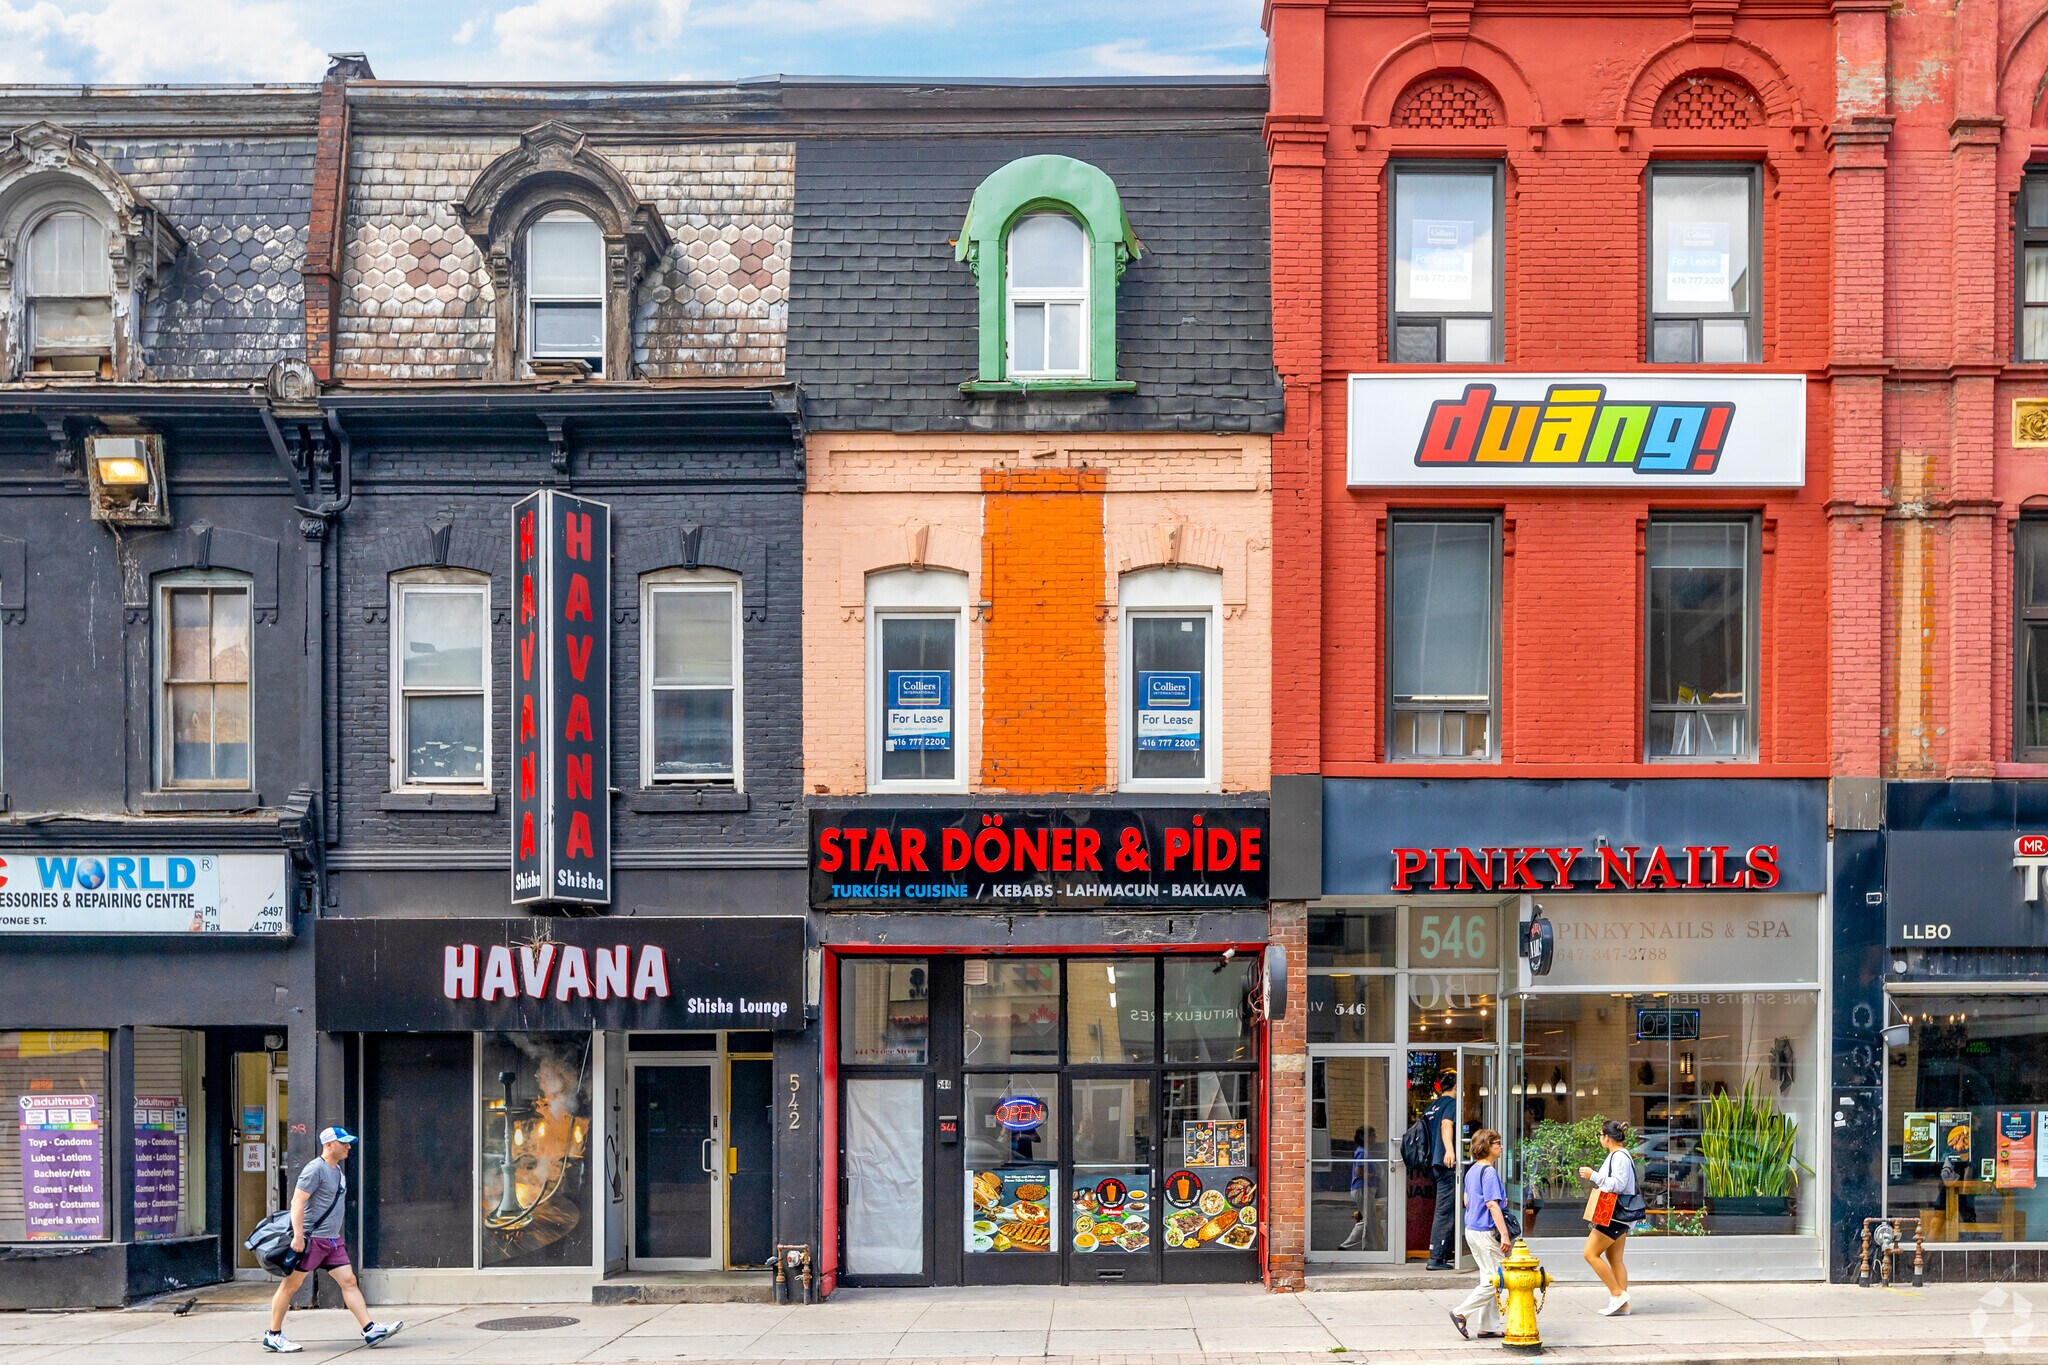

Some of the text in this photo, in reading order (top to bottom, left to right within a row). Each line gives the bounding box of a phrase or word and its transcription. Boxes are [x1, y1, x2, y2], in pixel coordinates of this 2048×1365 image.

[1671, 256, 1718, 266] For Lease
[1414, 274, 1430, 282] 416
[1431, 274, 1446, 282] 777
[1671, 276, 1725, 285] 416 777 2200
[519, 511, 536, 861] HAVANA
[565, 511, 594, 860] HAVANA
[903, 681, 936, 690] Colliers
[1153, 682, 1186, 691] Colliers
[892, 713, 944, 724] For Lease
[1142, 714, 1194, 725] For Lease
[908, 738, 923, 746] 777
[925, 738, 946, 746] 2200
[1141, 739, 1196, 747] 416 777 2200
[818, 827, 927, 873] STAR
[941, 813, 1102, 873] DÖNER
[1115, 827, 1149, 873] &
[2023, 839, 2046, 852] MR.
[35, 856, 197, 891] WORLD
[1390, 845, 1781, 891] PINKY NAILS
[515, 872, 541, 890] Shisha
[557, 869, 604, 892] Shisha
[831, 884, 901, 898] TURKISH
[905, 884, 968, 898] CUISINE
[992, 884, 1054, 898] KEBABS
[1065, 884, 1159, 898] LAHMACUN
[1172, 883, 1247, 897] BAKLAVA
[62, 892, 71, 908] &
[75, 892, 141, 909] REPAIRING
[146, 893, 195, 909] CENTRE
[205, 906, 217, 917] Ph
[33, 916, 47, 926] ST.
[205, 921, 220, 932] Fax
[1557, 920, 1792, 941] PINKY NAILS & SPA
[1903, 924, 1952, 940] LLBO
[1419, 915, 1487, 960] 546
[1556, 946, 1668, 961] 647-347-2788
[444, 943, 671, 1001] HAVANA
[687, 998, 788, 1018] Shisha Lounge
[1334, 1003, 1367, 1016] 546
[1640, 1014, 1696, 1036] OPEN
[937, 1080, 951, 1089] 544
[33, 1096, 90, 1107] adultmart
[138, 1097, 175, 1107] adultmart
[995, 1104, 1044, 1122] OPEN
[940, 1122, 957, 1132] 544
[28, 1137, 93, 1148] Toys Condoms
[134, 1138, 177, 1147] Toys Condoms
[30, 1153, 92, 1163] Lubes Lotions
[135, 1153, 176, 1162] Lubes Lotions
[33, 1168, 92, 1178] Bachelor/ette
[136, 1168, 176, 1178] Bachelor/ette
[33, 1184, 94, 1194] Games Fetish
[135, 1183, 176, 1193] Games Fetish
[28, 1200, 100, 1210] Shoes Costumes
[134, 1199, 178, 1208] hoes Costumes
[31, 1215, 100, 1226] Lingerie & more!
[153, 1214, 159, 1223] &
[159, 1212, 177, 1222] more!
